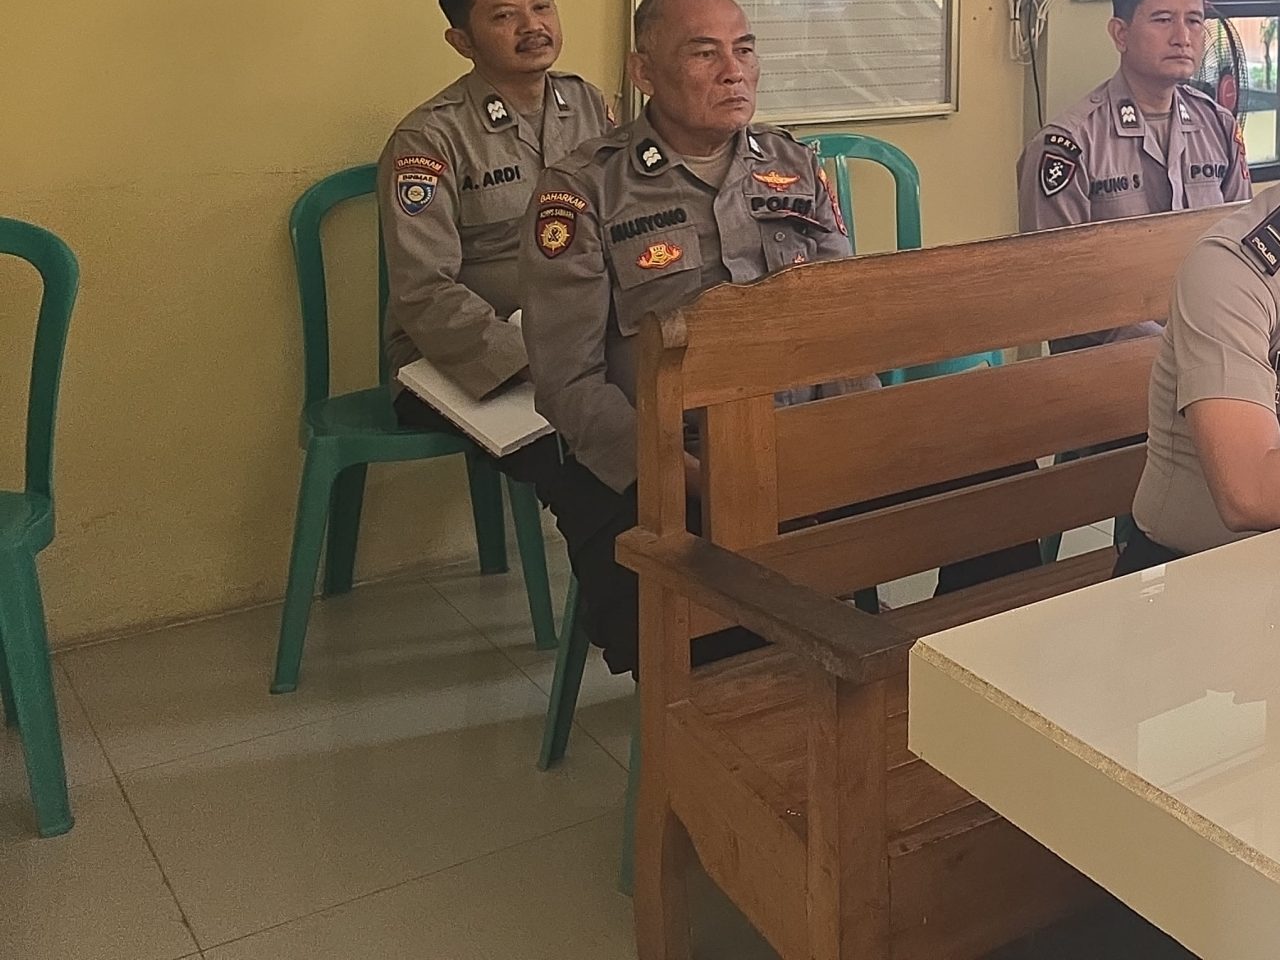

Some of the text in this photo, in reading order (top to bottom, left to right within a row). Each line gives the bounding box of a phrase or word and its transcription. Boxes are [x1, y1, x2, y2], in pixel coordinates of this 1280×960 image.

[1050, 136, 1077, 151] SPKT
[398, 157, 442, 171] BAHARKAM
[462, 165, 520, 190] A. ARDI
[1132, 174, 1140, 189] S
[540, 193, 585, 210] BAHARKAM
[1252, 237, 1277, 265] POLISI
